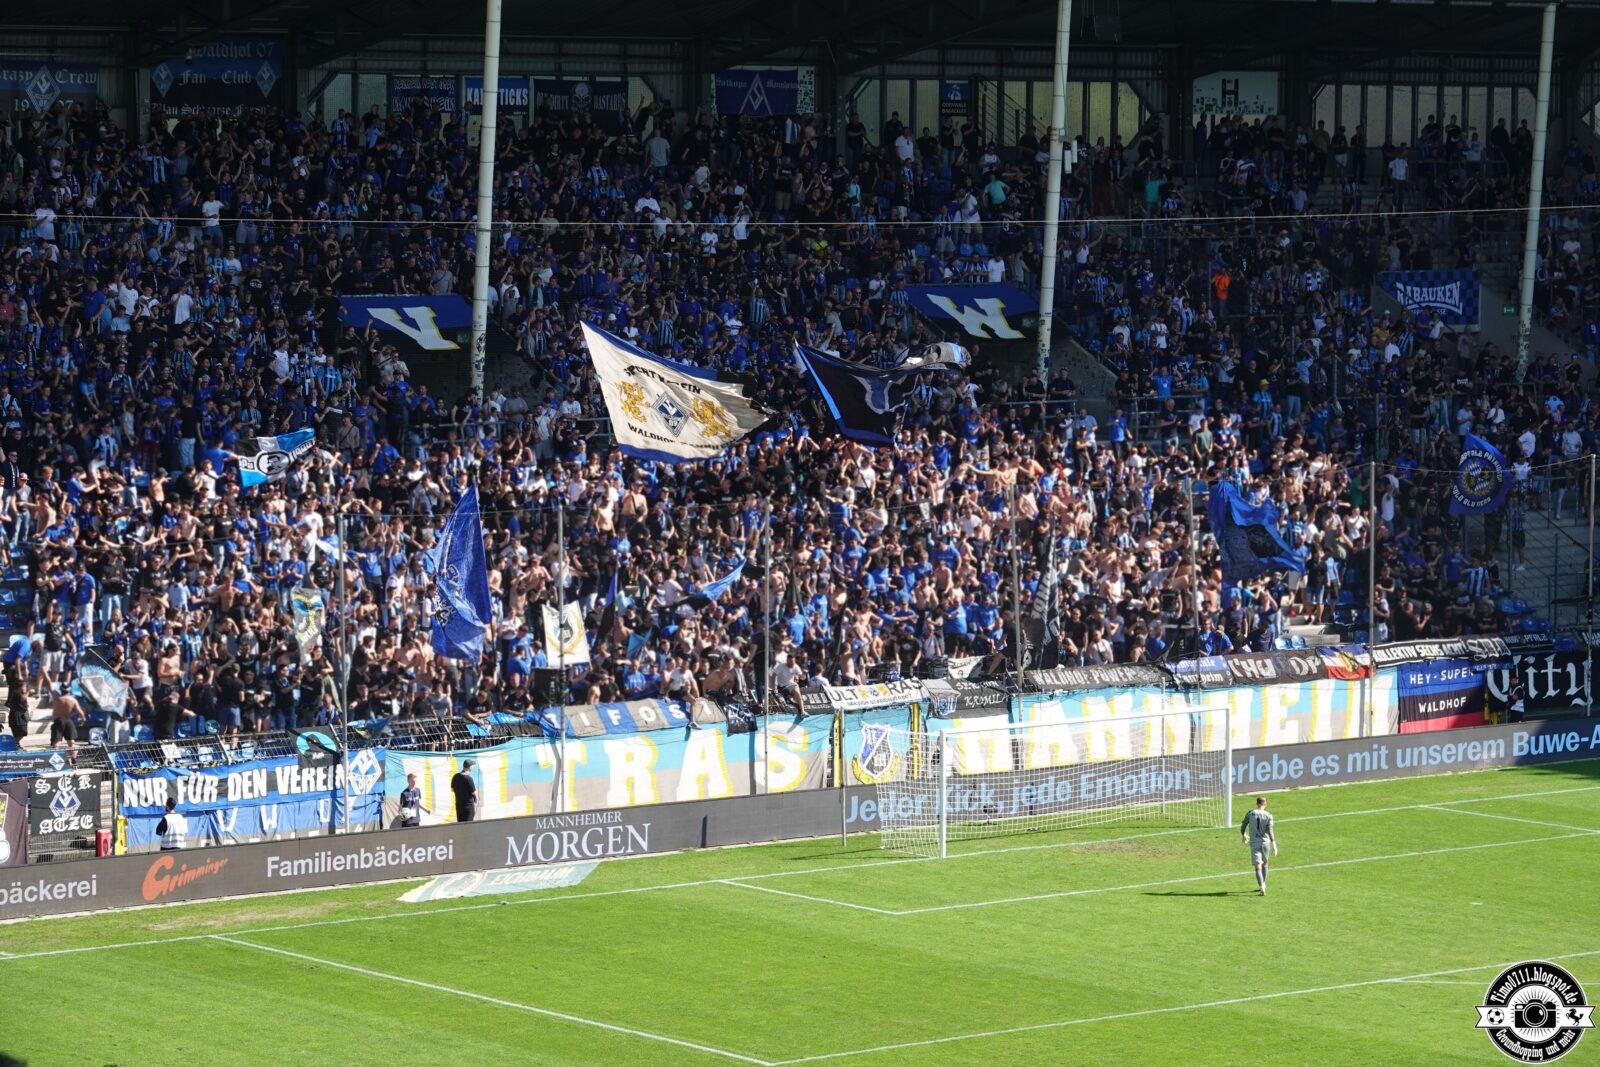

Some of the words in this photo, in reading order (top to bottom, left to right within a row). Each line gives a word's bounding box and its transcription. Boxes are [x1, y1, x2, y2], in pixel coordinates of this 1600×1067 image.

[0, 70, 33, 85] razy
[55, 69, 97, 84] Crew
[177, 69, 207, 86] Fan
[221, 70, 251, 85] Club
[1396, 281, 1462, 306] RABAUKEN
[1487, 653, 1594, 706] City
[1418, 697, 1468, 713] WALDHOF
[955, 676, 1394, 778] MANNHEIM
[123, 777, 168, 807] NUR
[176, 773, 218, 804] FÜR
[227, 769, 268, 802] DEN
[275, 761, 348, 796] VEREIN
[402, 724, 812, 829] ULTRAS
[846, 789, 928, 823] Jeder
[937, 782, 1005, 816] Kick,
[1010, 775, 1072, 817] jede
[1080, 764, 1191, 802] Emotion
[1221, 755, 1305, 788] erlebe
[1311, 756, 1341, 778] es
[1347, 743, 1389, 773] mit
[1396, 736, 1506, 769] unserem
[536, 811, 622, 831] MANNHEIMER
[266, 840, 455, 879] Familienbäckerei
[506, 823, 651, 866] MORGEN
[142, 855, 229, 902] Grimminger
